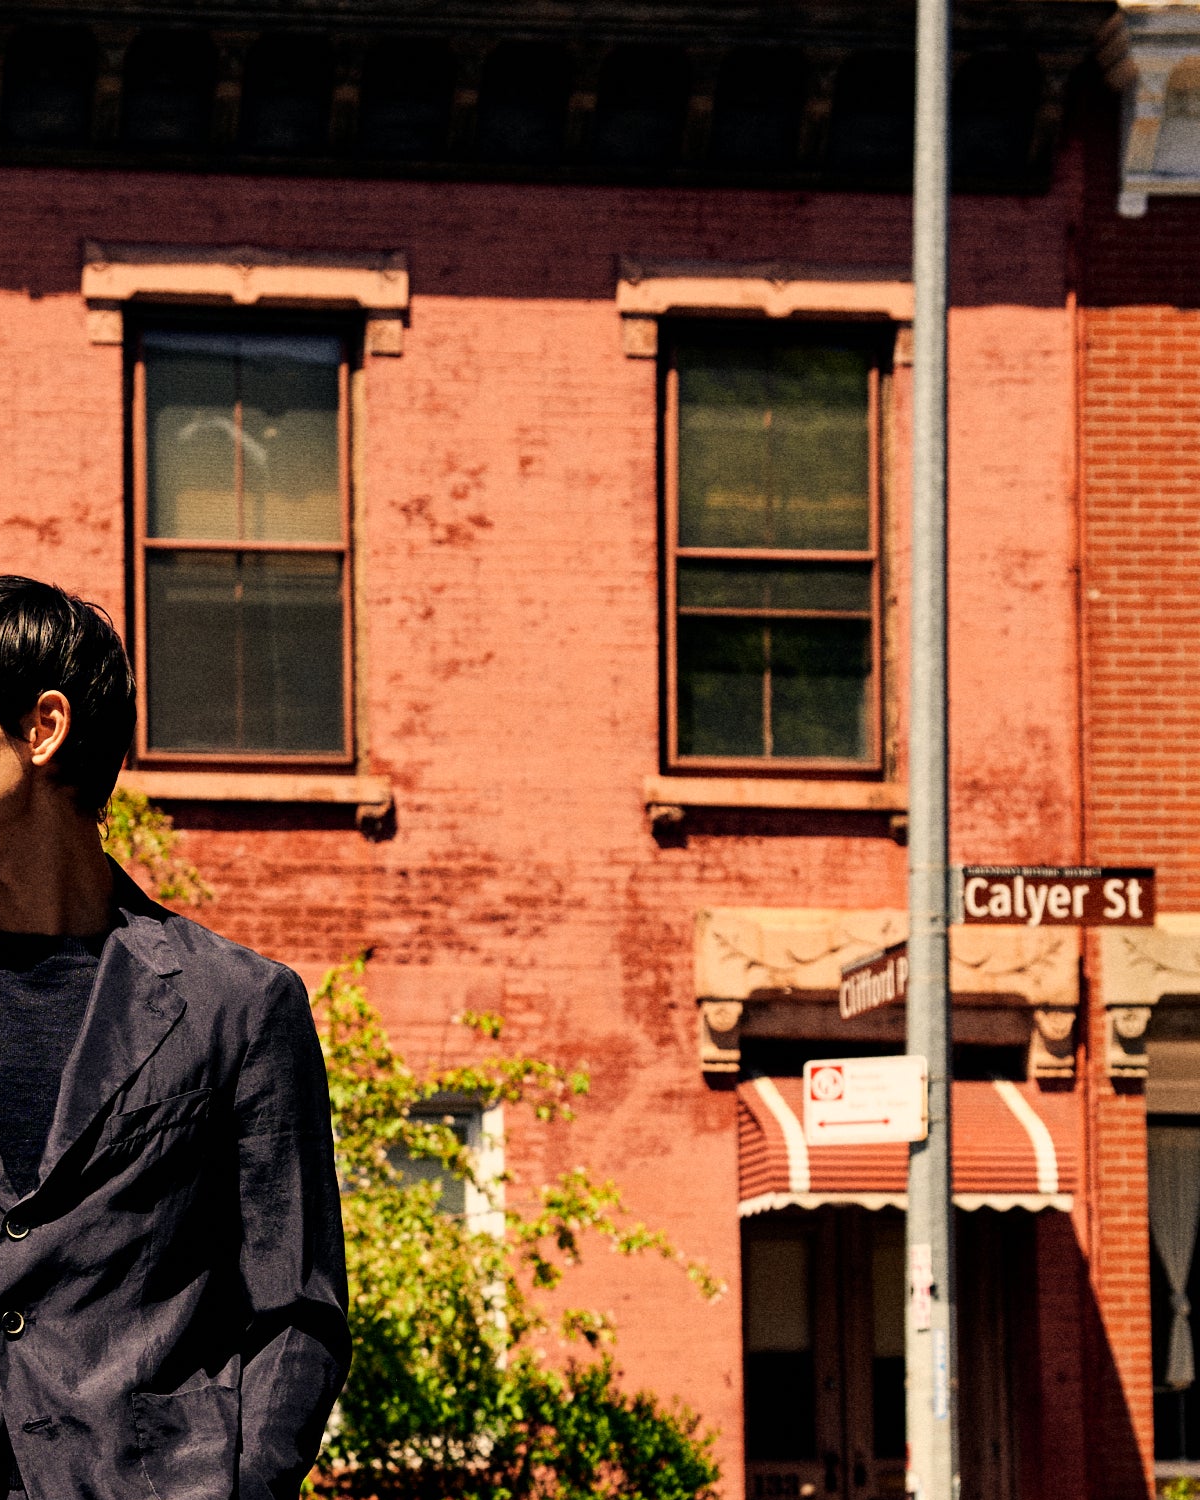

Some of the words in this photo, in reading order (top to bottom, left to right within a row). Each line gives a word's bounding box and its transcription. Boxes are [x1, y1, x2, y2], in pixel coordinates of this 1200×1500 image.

[964, 876, 1090, 926] Calyer
[1103, 878, 1143, 919] St
[896, 956, 909, 995] P
